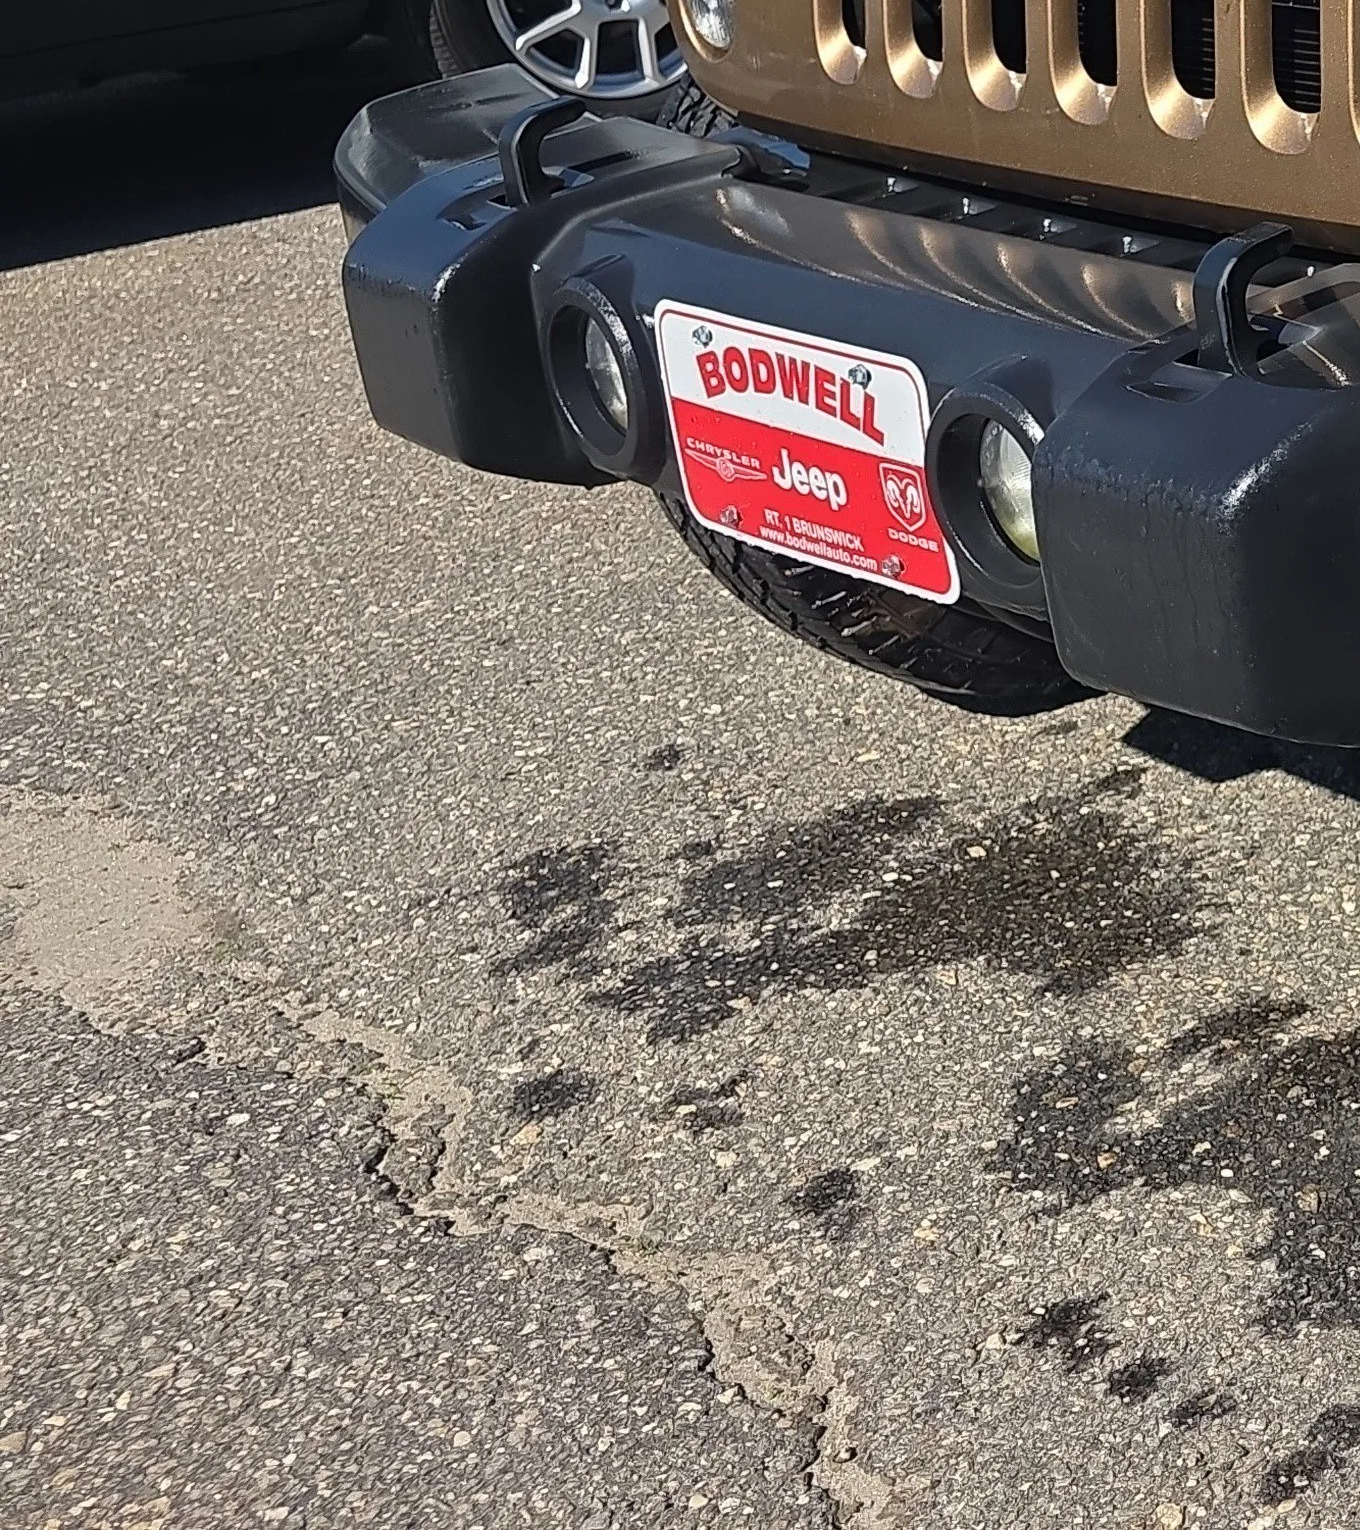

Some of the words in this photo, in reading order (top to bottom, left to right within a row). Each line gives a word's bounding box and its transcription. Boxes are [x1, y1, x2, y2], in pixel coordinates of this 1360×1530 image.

[695, 345, 885, 447] BODWELL
[686, 437, 761, 469] CHRYSLER
[772, 448, 848, 511] Jeep
[759, 525, 878, 571] www.bodwellauto.com
[764, 508, 783, 529] RT.
[784, 515, 792, 531] 1
[792, 517, 865, 552] BRUNSWICK
[888, 527, 939, 553] DODGE
